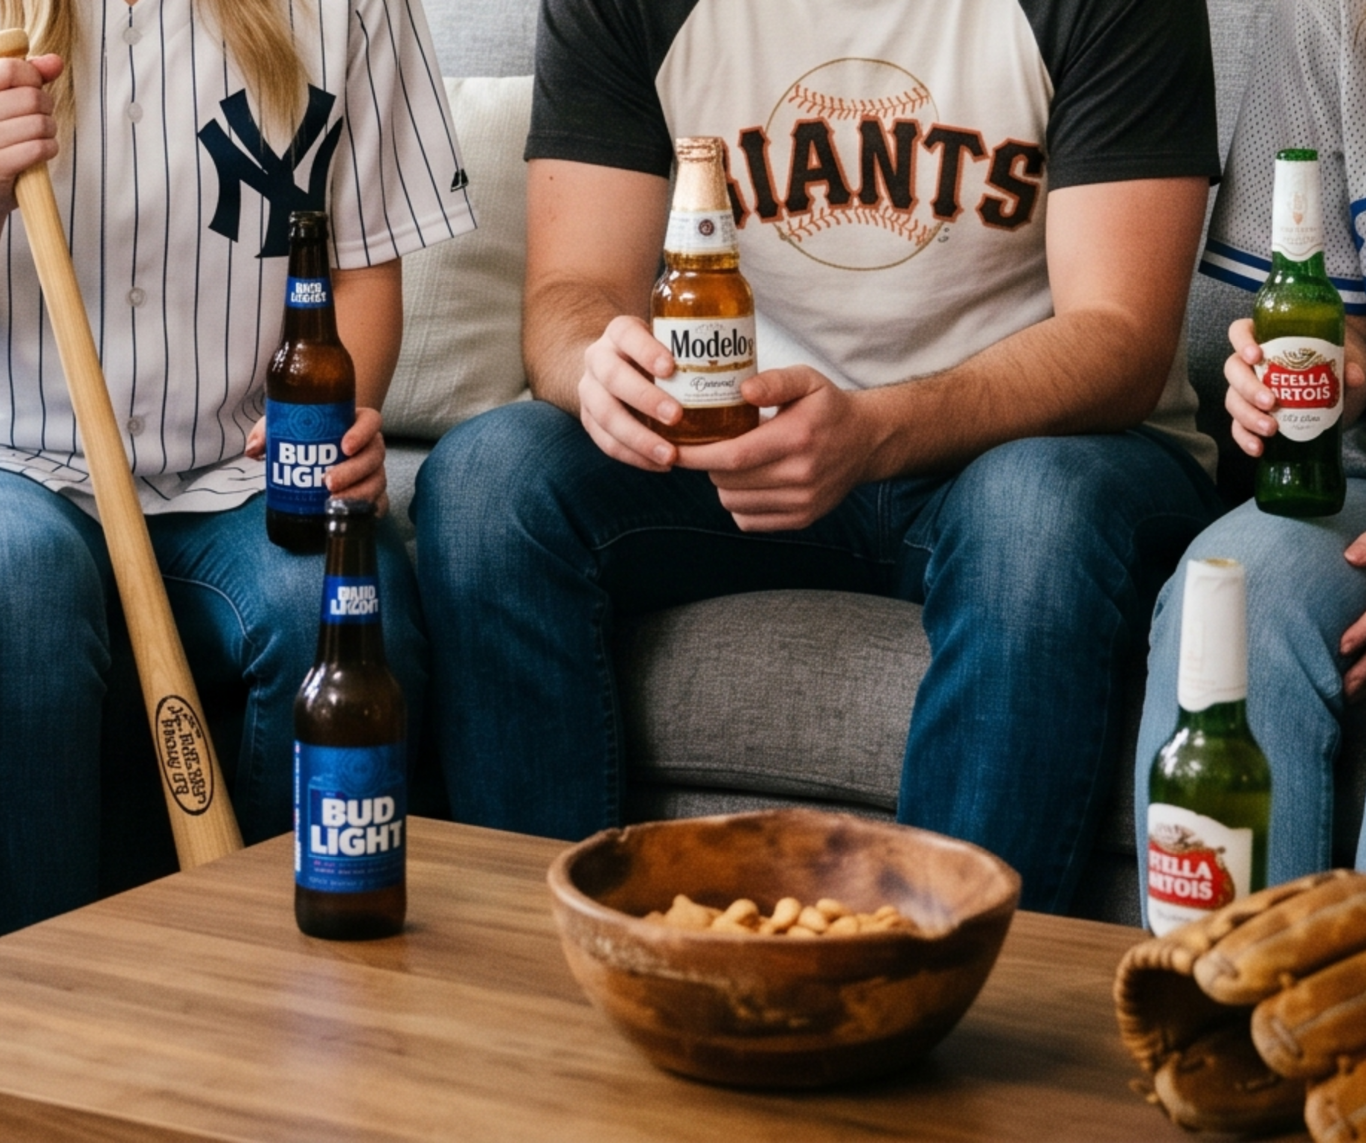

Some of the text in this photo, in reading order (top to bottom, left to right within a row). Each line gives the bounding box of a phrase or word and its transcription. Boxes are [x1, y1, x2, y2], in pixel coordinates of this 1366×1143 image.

[723, 115, 1047, 233] IANTS
[670, 328, 747, 359] Modelo
[279, 443, 338, 466] BUD
[272, 462, 329, 488] LIGH
[322, 795, 395, 828] BUD
[310, 820, 403, 856] LIGHT
